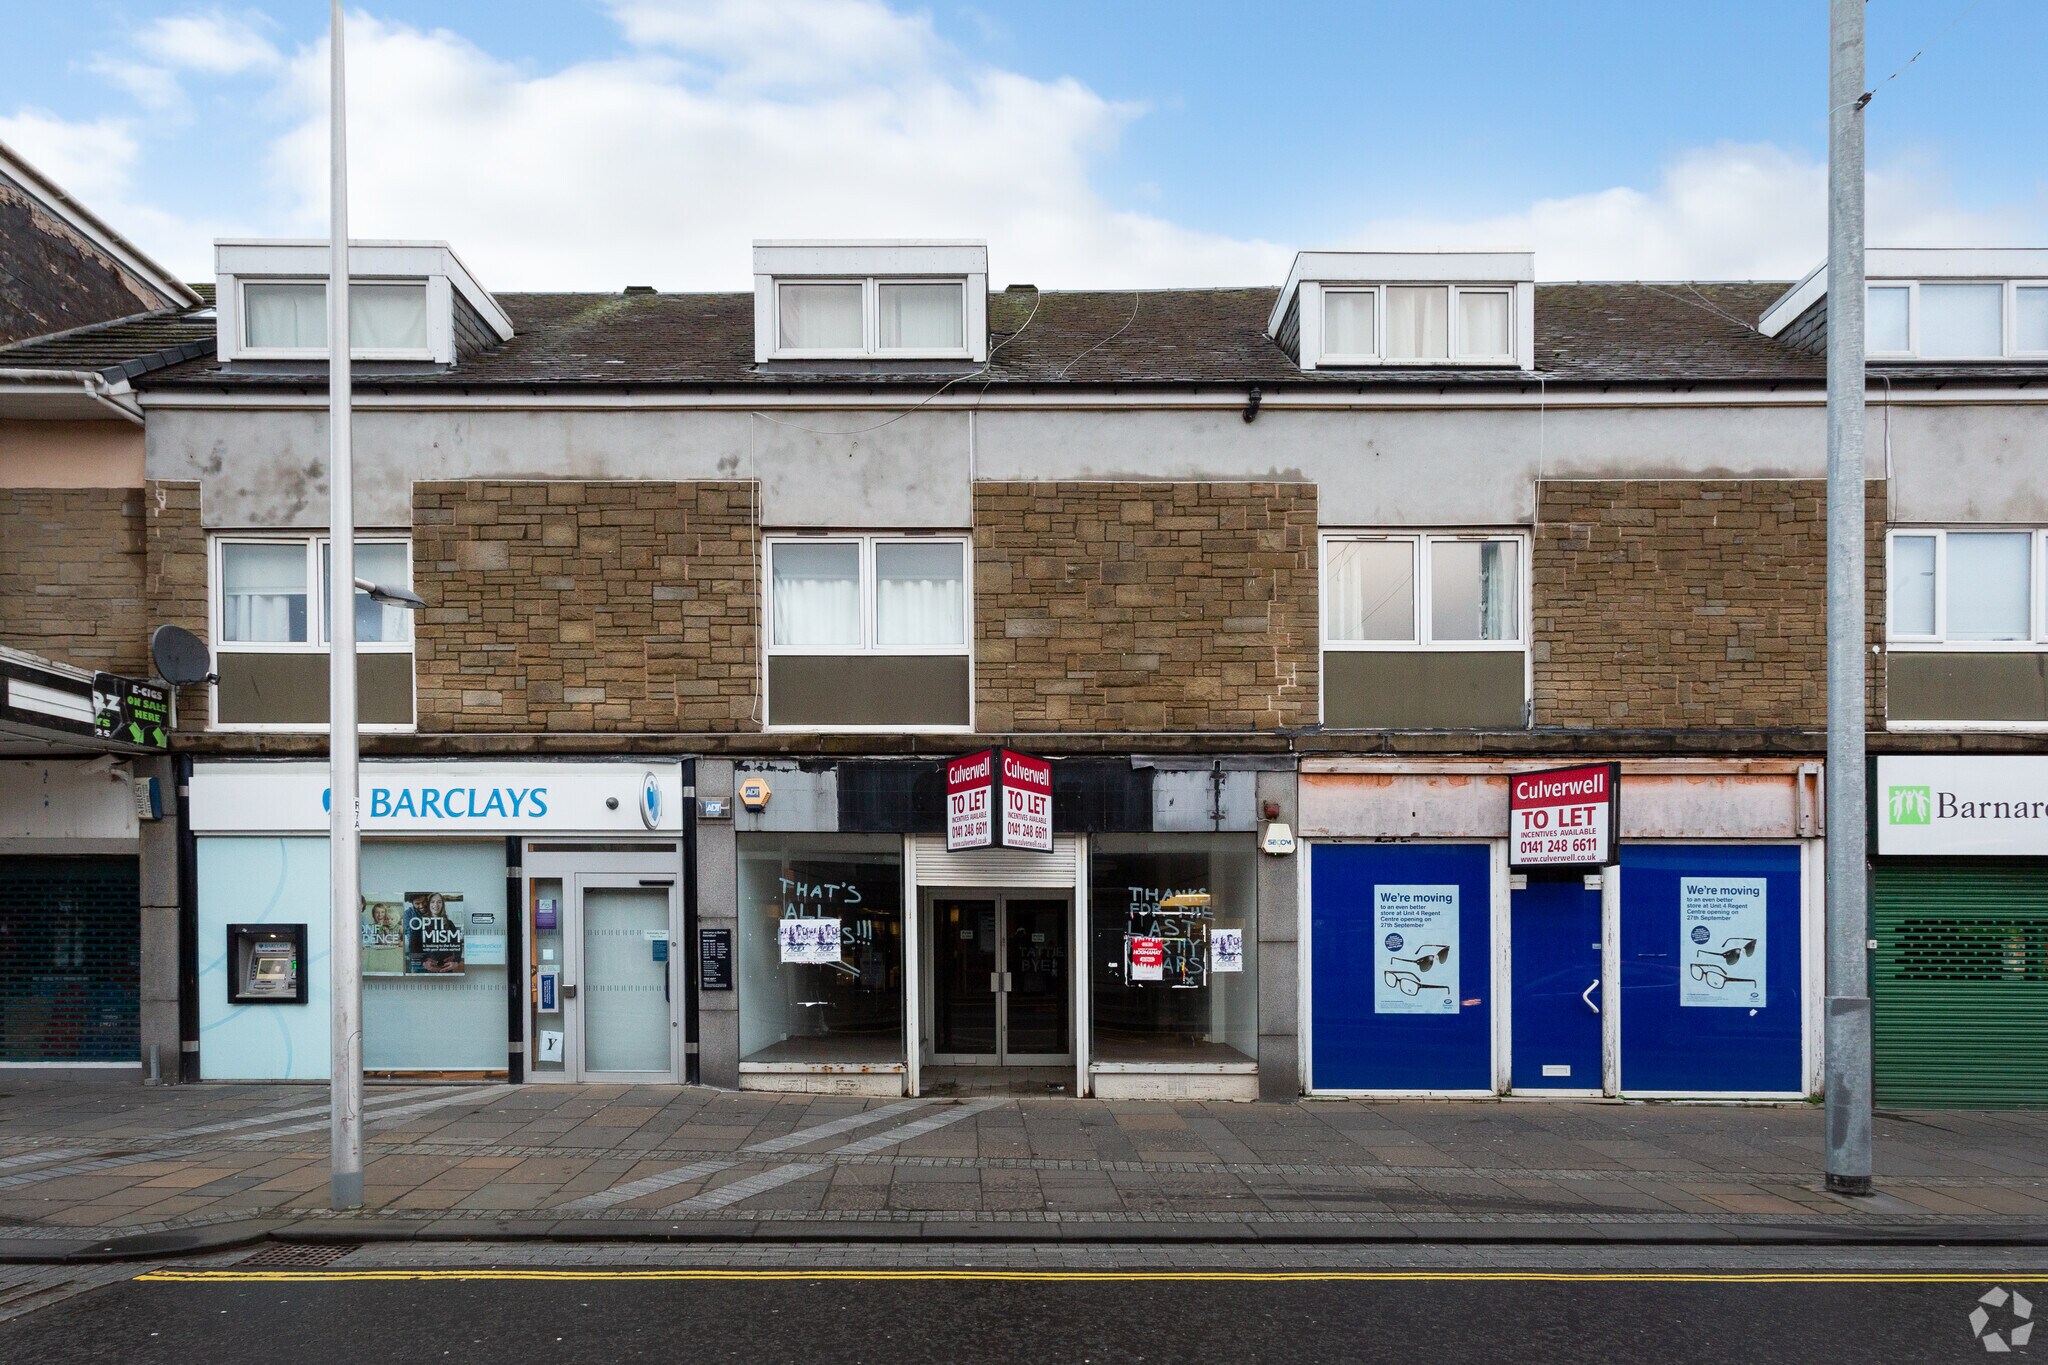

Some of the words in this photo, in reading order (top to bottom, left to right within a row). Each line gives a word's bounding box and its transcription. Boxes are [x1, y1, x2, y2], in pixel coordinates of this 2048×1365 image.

[132, 684, 162, 700] E-CIGS
[127, 696, 141, 706] ON
[143, 700, 167, 712] SALE
[134, 710, 160, 723] HERE
[96, 728, 111, 738] 25
[950, 756, 990, 785] Culverwell
[1004, 758, 1049, 786] Culverwell
[1516, 774, 1604, 800] Culverwell
[370, 788, 548, 819] BARCLAYS
[952, 794, 965, 814] TO
[969, 790, 986, 811] LET
[1008, 790, 1023, 811] TO
[1028, 794, 1046, 815] LET
[1008, 811, 1028, 820] INCENTIVES
[1029, 816, 1047, 824] AVAILABLE
[1522, 810, 1548, 830] TO
[1558, 806, 1596, 827] LET
[952, 825, 963, 839] 0141
[965, 823, 974, 836] 248
[976, 822, 987, 835] 6611
[1008, 821, 1020, 835] 0141
[1023, 824, 1033, 837] 248
[1035, 826, 1047, 839] 6611
[1521, 830, 1557, 838] INCENTIVES
[1521, 841, 1542, 854] 0141
[1548, 840, 1567, 852] 248
[1573, 838, 1596, 852] 6611
[1521, 854, 1596, 862] www.culverwell.co.uk
[779, 878, 862, 903] THAT'S
[1128, 886, 1211, 902] THANKS
[1381, 893, 1410, 902] We're
[1414, 893, 1452, 904] moving
[1687, 885, 1717, 895] We're
[1720, 886, 1760, 897] moving
[784, 903, 833, 919] ALL
[1130, 903, 1162, 917] FOR
[1178, 906, 1216, 921] THE
[409, 917, 444, 930] OPTI
[1127, 919, 1196, 937] LAST
[422, 930, 460, 943] MISM
